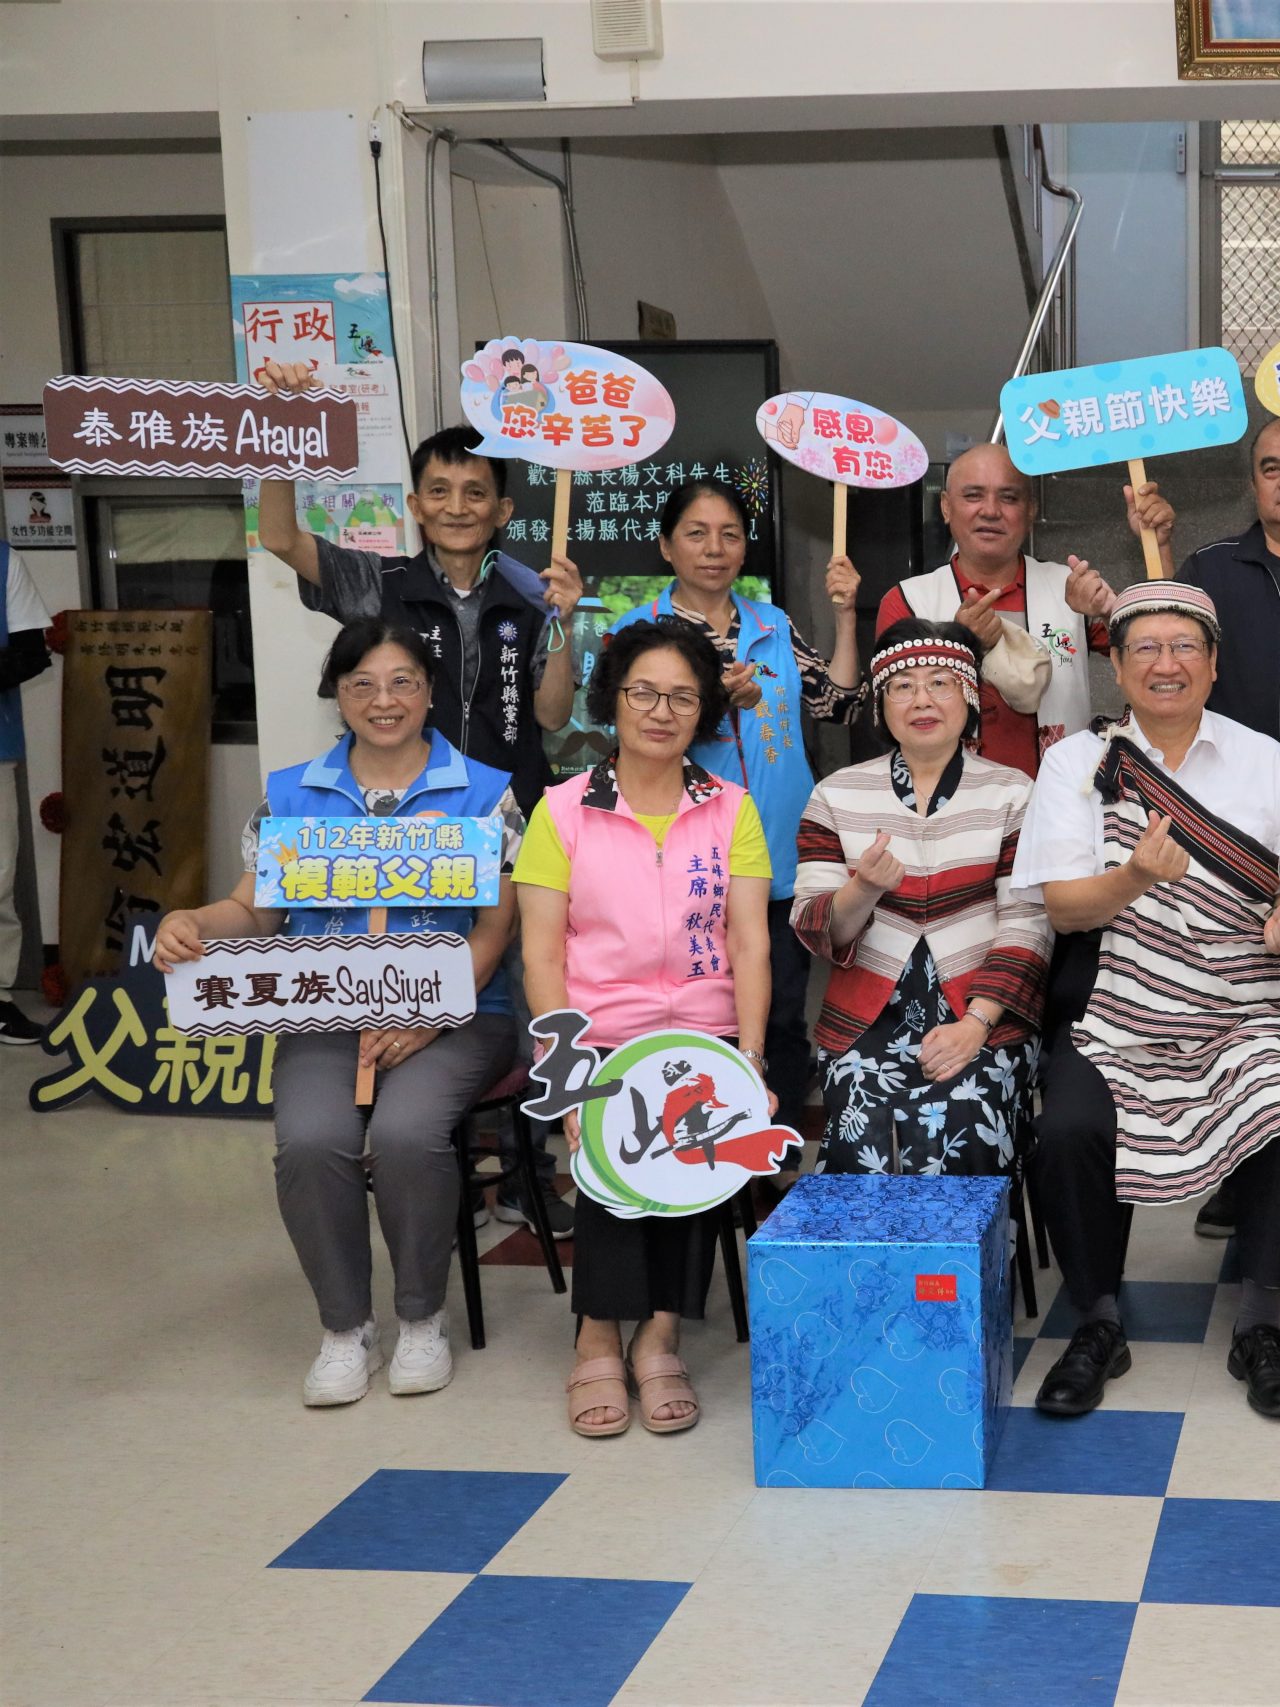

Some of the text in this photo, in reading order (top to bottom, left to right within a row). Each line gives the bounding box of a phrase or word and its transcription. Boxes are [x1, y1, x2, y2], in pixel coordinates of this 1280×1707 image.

[246, 307, 336, 343] 行政
[564, 369, 636, 409] 爸爸
[500, 405, 647, 448] 您辛苦了
[812, 407, 876, 445] 感恩
[1019, 376, 1232, 446] 父親節快樂
[832, 444, 894, 481] 有您
[506, 518, 662, 542] 頒發揚縣代表
[500, 644, 520, 744] 新竹縣黨部
[297, 823, 464, 851] 112年新竹縣
[280, 854, 478, 901] 模範父親
[687, 854, 708, 898] 主席
[704, 846, 724, 972] 五峰鄉民代表會
[37, 986, 273, 1106] 父親
